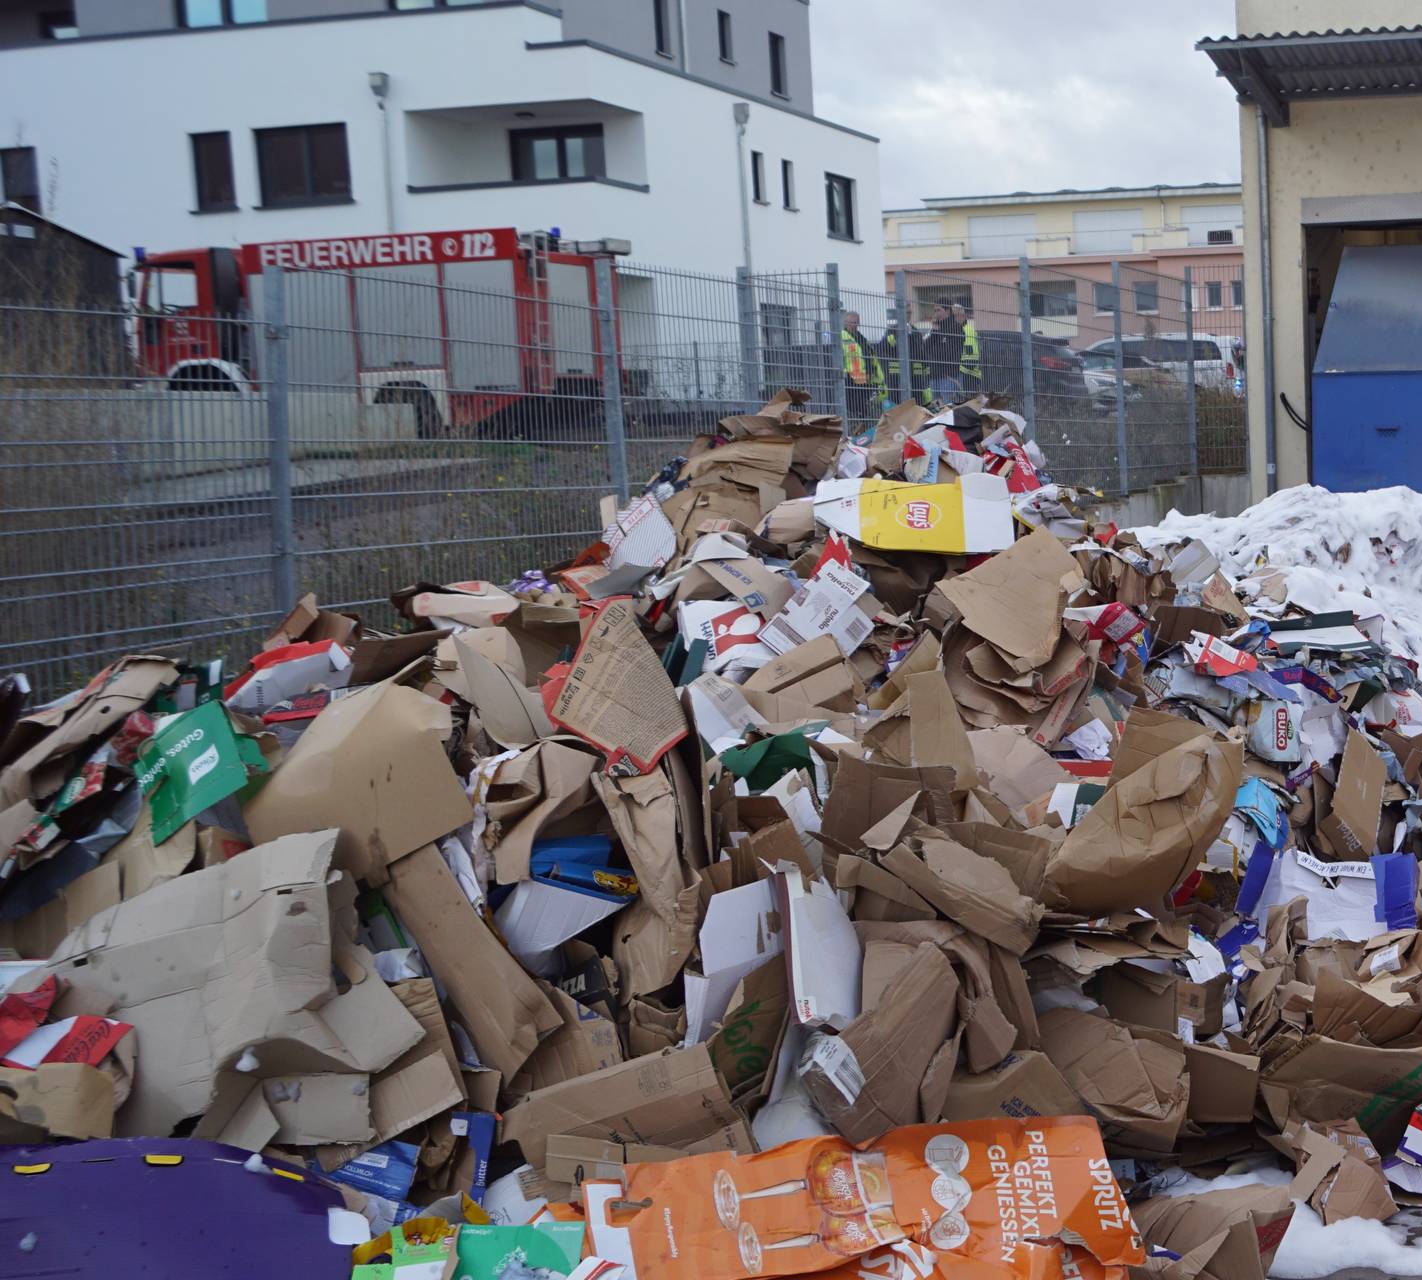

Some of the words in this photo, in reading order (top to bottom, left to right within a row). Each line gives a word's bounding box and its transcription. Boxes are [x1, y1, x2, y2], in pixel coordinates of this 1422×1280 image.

[259, 235, 433, 267] FEUERWEHR
[461, 232, 496, 258] 112
[826, 571, 856, 596] nutella
[818, 608, 839, 630] nutella
[560, 685, 579, 716] Fragile
[1277, 710, 1286, 747] BUKO
[476, 1158, 489, 1188] Butter
[1025, 1130, 1058, 1219] PERFEKT
[987, 1144, 1018, 1264] GENIESSEN
[1014, 1160, 1042, 1240] GEMIXT
[1088, 1158, 1124, 1231] SPRITZ
